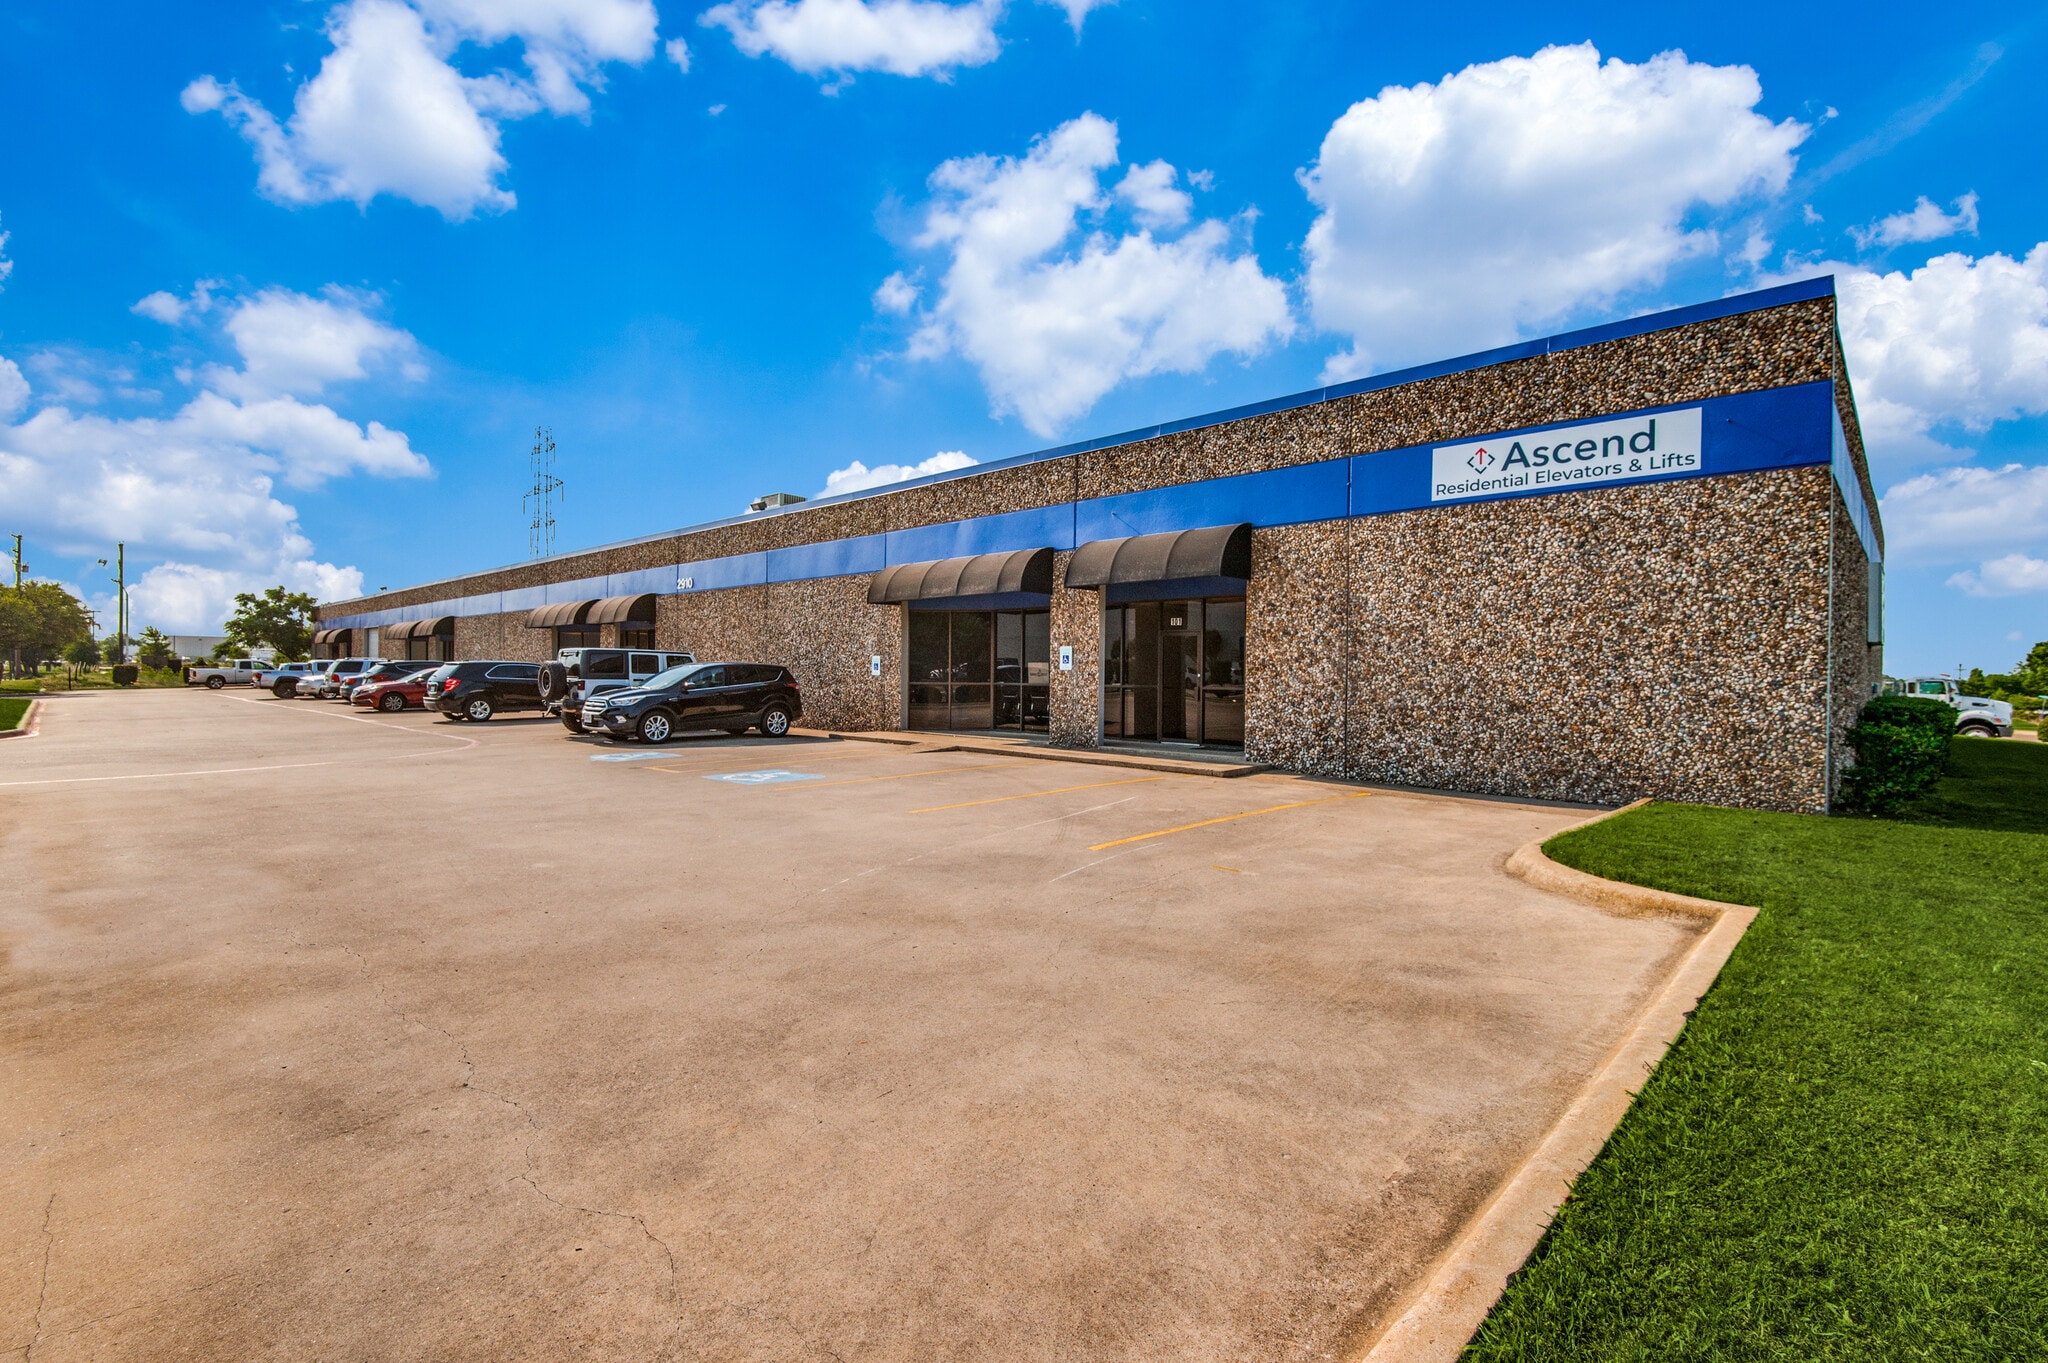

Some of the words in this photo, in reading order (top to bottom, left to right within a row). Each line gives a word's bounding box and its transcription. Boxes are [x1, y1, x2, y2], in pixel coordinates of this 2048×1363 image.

[1500, 418, 1656, 471] Ascend
[1436, 472, 1529, 496] Residential
[1535, 463, 1622, 484] Elevators
[1629, 458, 1643, 472] &
[1650, 453, 1696, 470] Lifts
[677, 577, 693, 590] 2910
